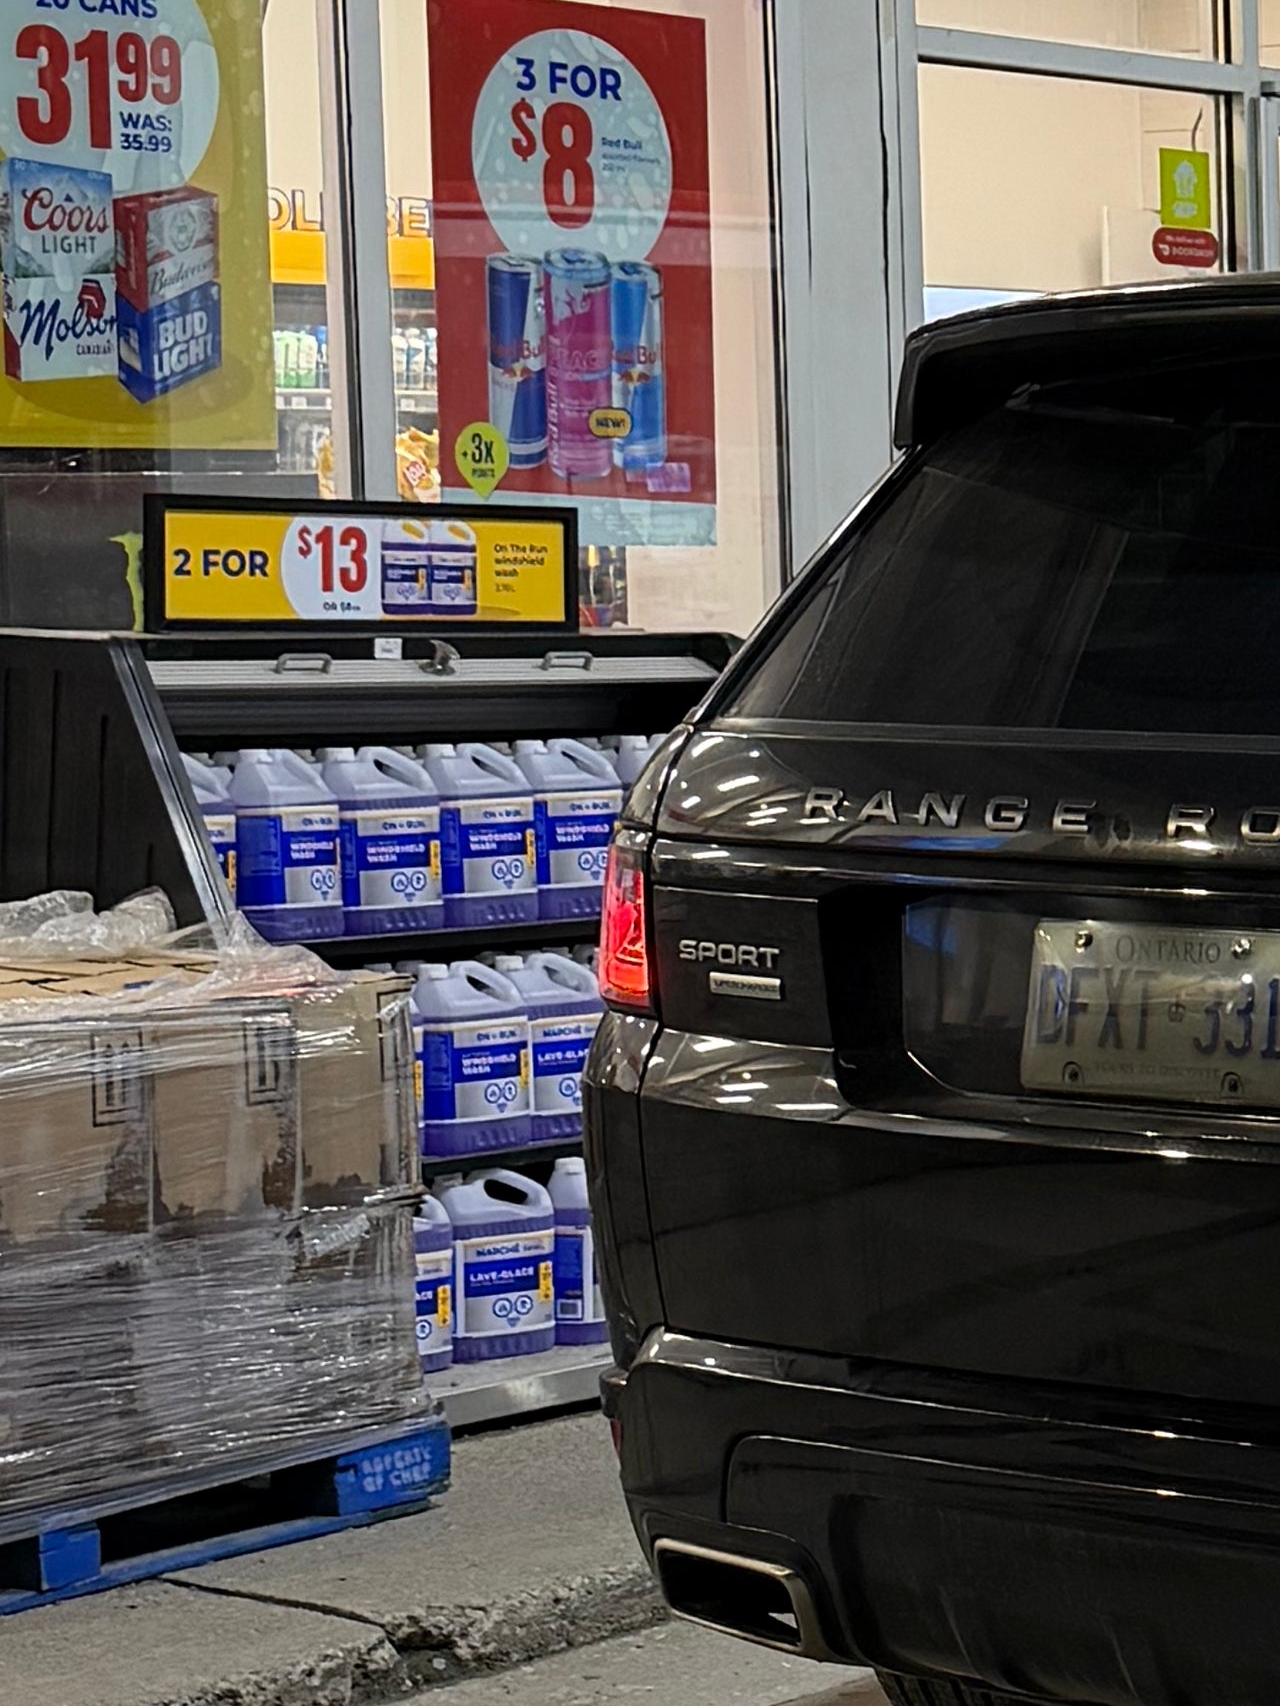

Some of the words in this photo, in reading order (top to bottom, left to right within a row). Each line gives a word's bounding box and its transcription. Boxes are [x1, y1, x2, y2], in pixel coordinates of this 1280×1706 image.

[516, 57, 536, 91] 3
[548, 61, 622, 101] FOR
[119, 111, 172, 132] WAS:
[120, 133, 172, 153] 35.99
[21, 186, 109, 232] Coors
[41, 235, 97, 254] LIGHT
[159, 309, 208, 349] BUD
[153, 333, 214, 380] LIGHT
[173, 548, 191, 576] 2
[203, 549, 269, 577] FOR
[298, 525, 367, 593] $13
[510, 543, 527, 554] The
[801, 785, 1096, 834] RANGE
[679, 939, 780, 968] SPORT
[1116, 935, 1221, 963] ONTARIO
